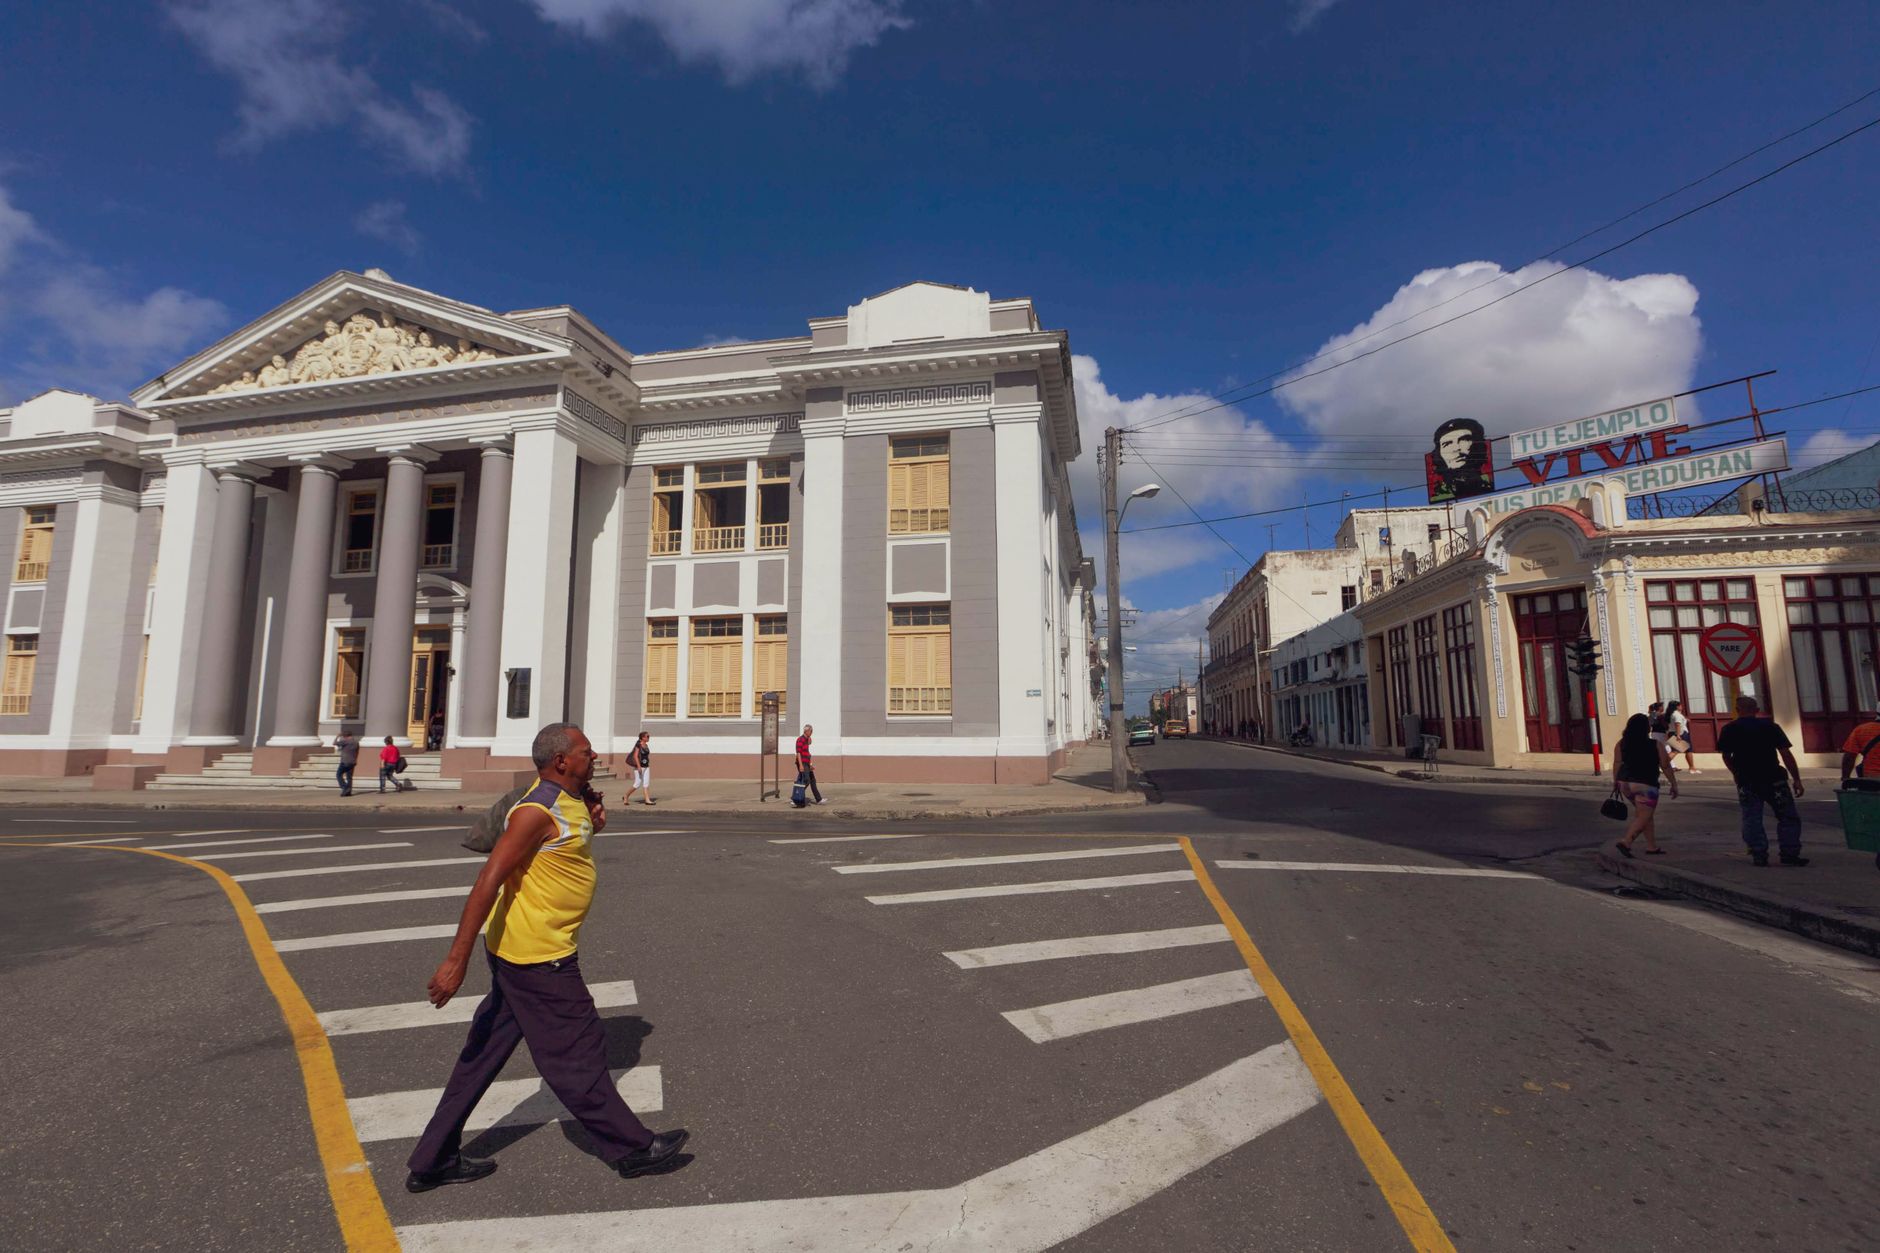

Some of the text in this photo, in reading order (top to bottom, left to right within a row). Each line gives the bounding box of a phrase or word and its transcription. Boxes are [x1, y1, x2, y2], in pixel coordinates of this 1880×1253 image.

[1512, 424, 1691, 485] VIVE
[1517, 402, 1669, 453] TU EJEMPLO
[1532, 481, 1591, 506] IDEA
[1609, 449, 1753, 493] ERDURAN
